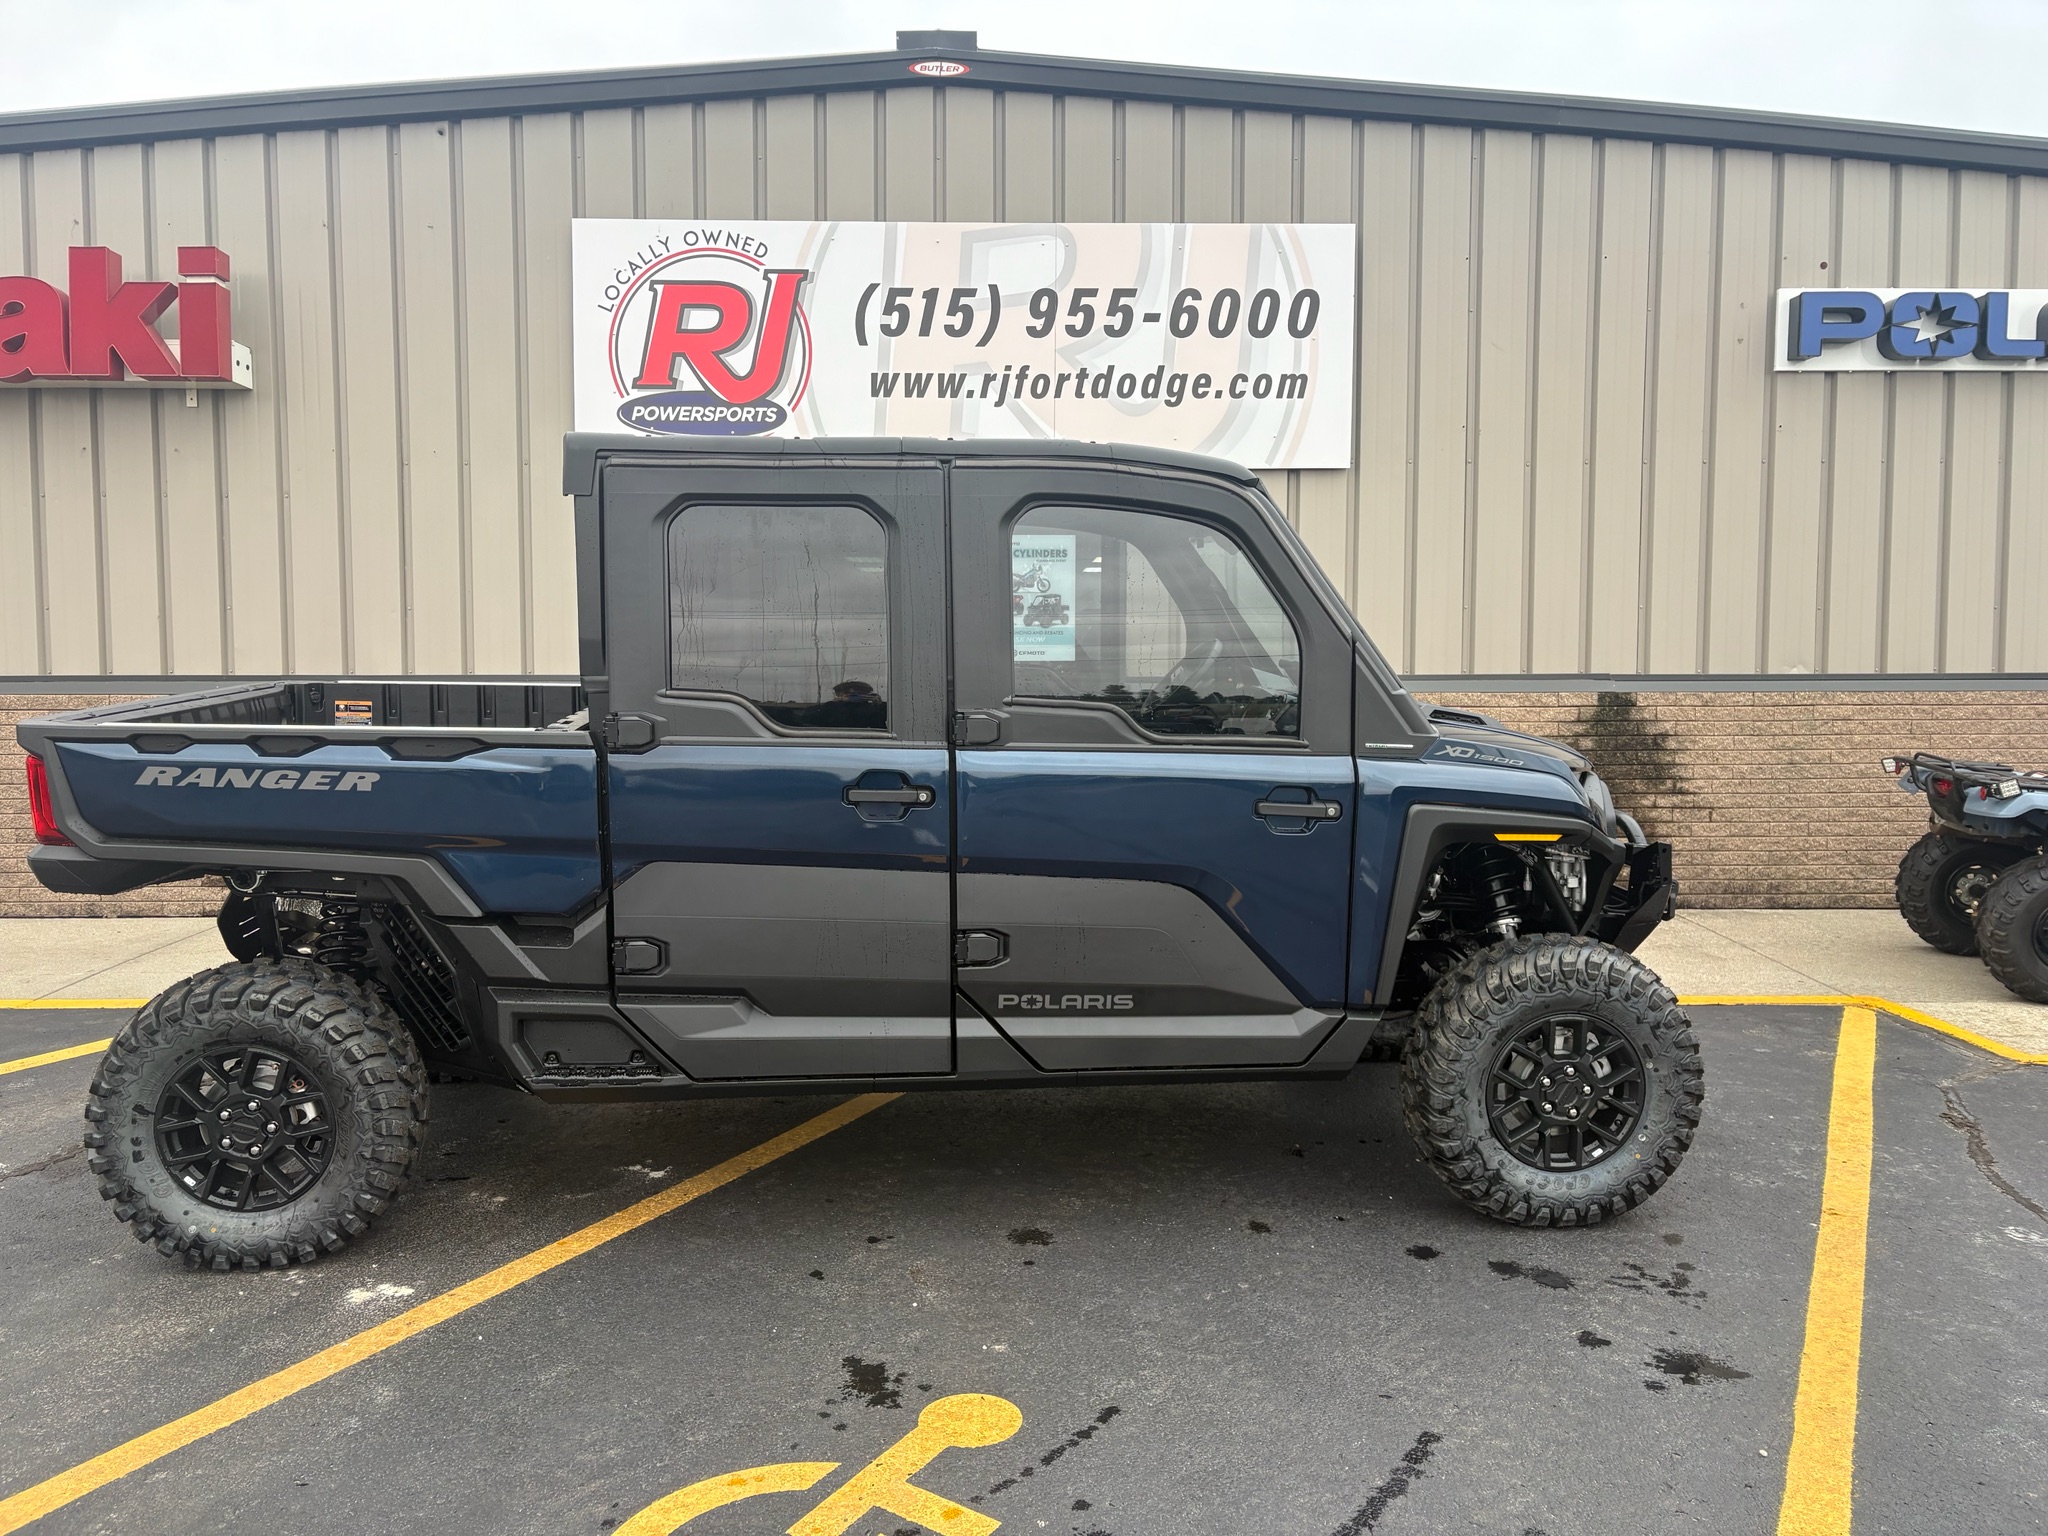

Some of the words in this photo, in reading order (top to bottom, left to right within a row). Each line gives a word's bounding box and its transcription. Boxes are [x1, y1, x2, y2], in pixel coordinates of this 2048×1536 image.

[919, 64, 960, 73] BUTLER
[597, 236, 672, 313] LOCALLY
[683, 229, 769, 259] OWNED
[854, 283, 1002, 347] (515)
[1025, 287, 1321, 339] 955-6000
[631, 269, 812, 405] RJ
[870, 364, 1309, 408] www.rjfortdodge.com
[631, 405, 778, 423] POWERSPORTS
[1013, 549, 1068, 558] CYLINDERS
[134, 766, 381, 792] RANGER
[997, 994, 1135, 1010] POLARIS
